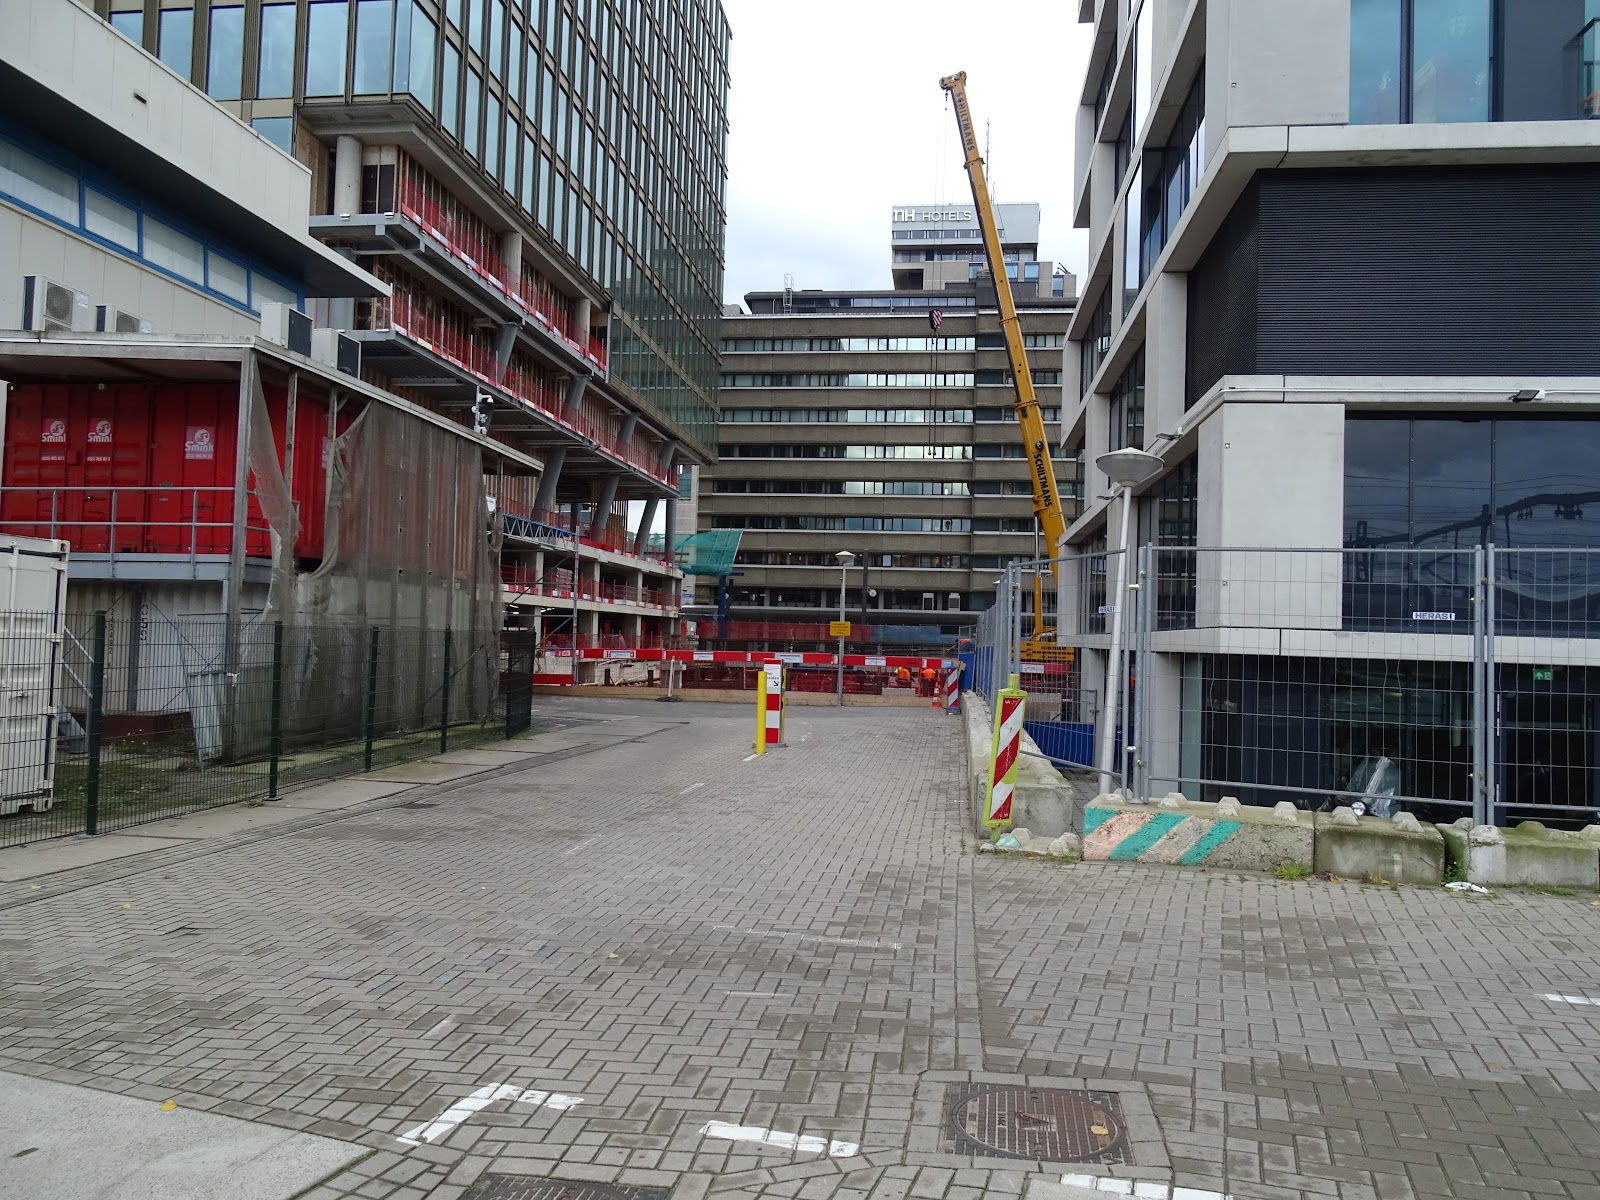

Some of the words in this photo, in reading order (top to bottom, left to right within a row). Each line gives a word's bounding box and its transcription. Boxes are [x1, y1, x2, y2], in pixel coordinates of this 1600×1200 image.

[956, 92, 975, 151] SCHILTMANS
[922, 211, 972, 221] HOTELS
[185, 441, 214, 451] Smink
[1034, 453, 1053, 507] SCHILTMANS
